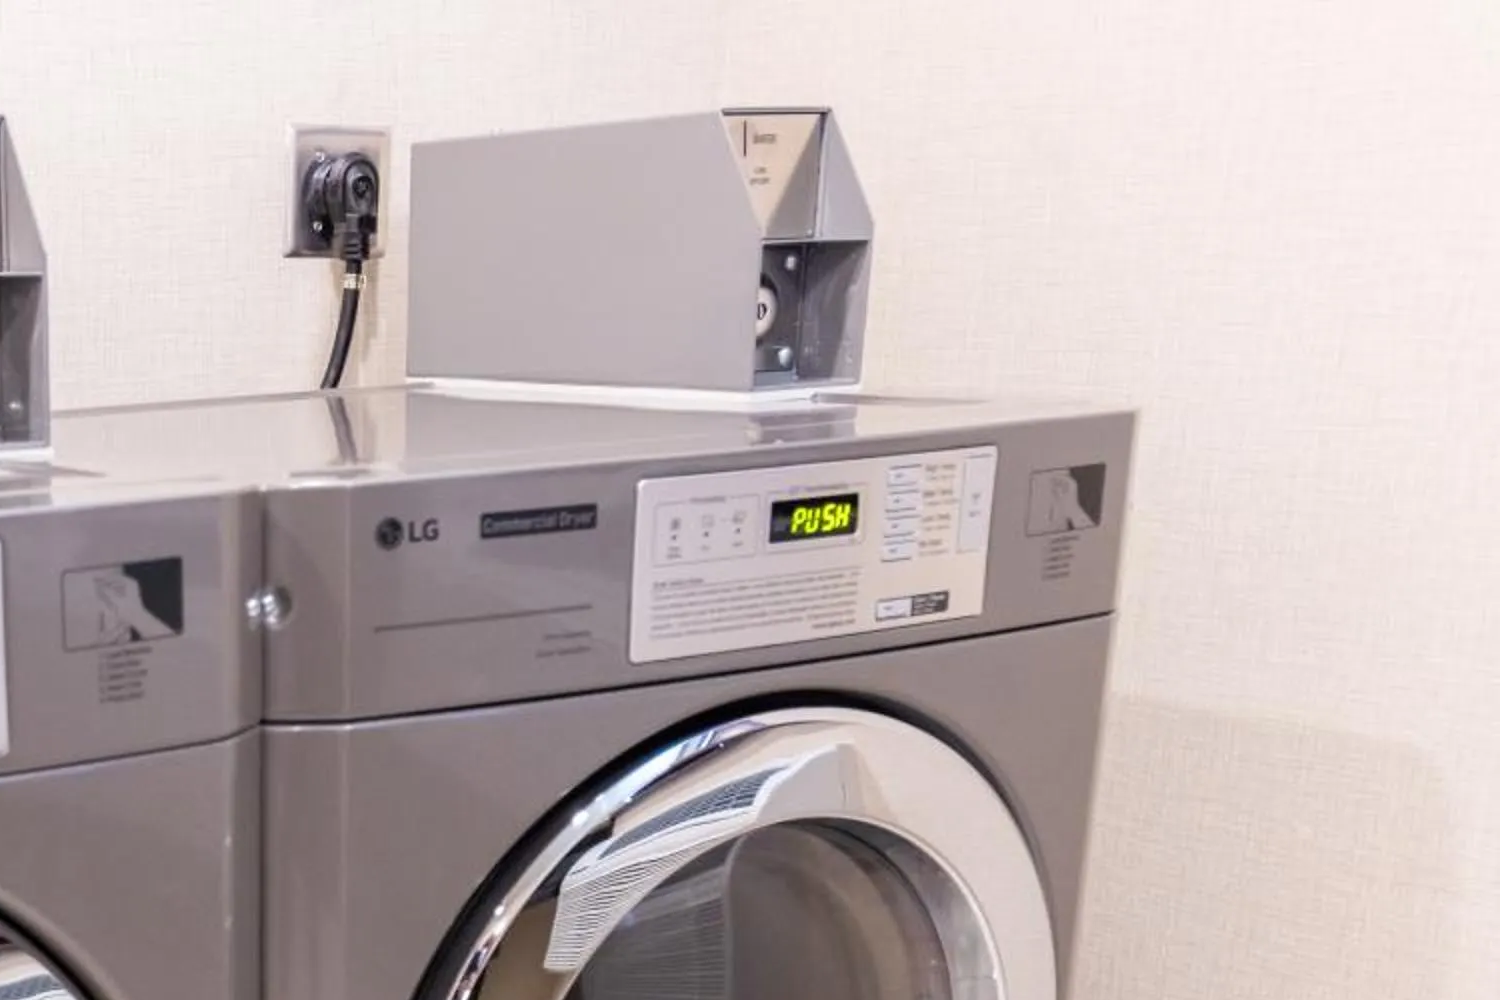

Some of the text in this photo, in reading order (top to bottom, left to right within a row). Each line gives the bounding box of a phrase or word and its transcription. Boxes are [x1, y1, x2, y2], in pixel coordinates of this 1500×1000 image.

[408, 518, 440, 543] LG
[484, 510, 594, 534] Commercial Dryer
[790, 503, 851, 535] PUSH
